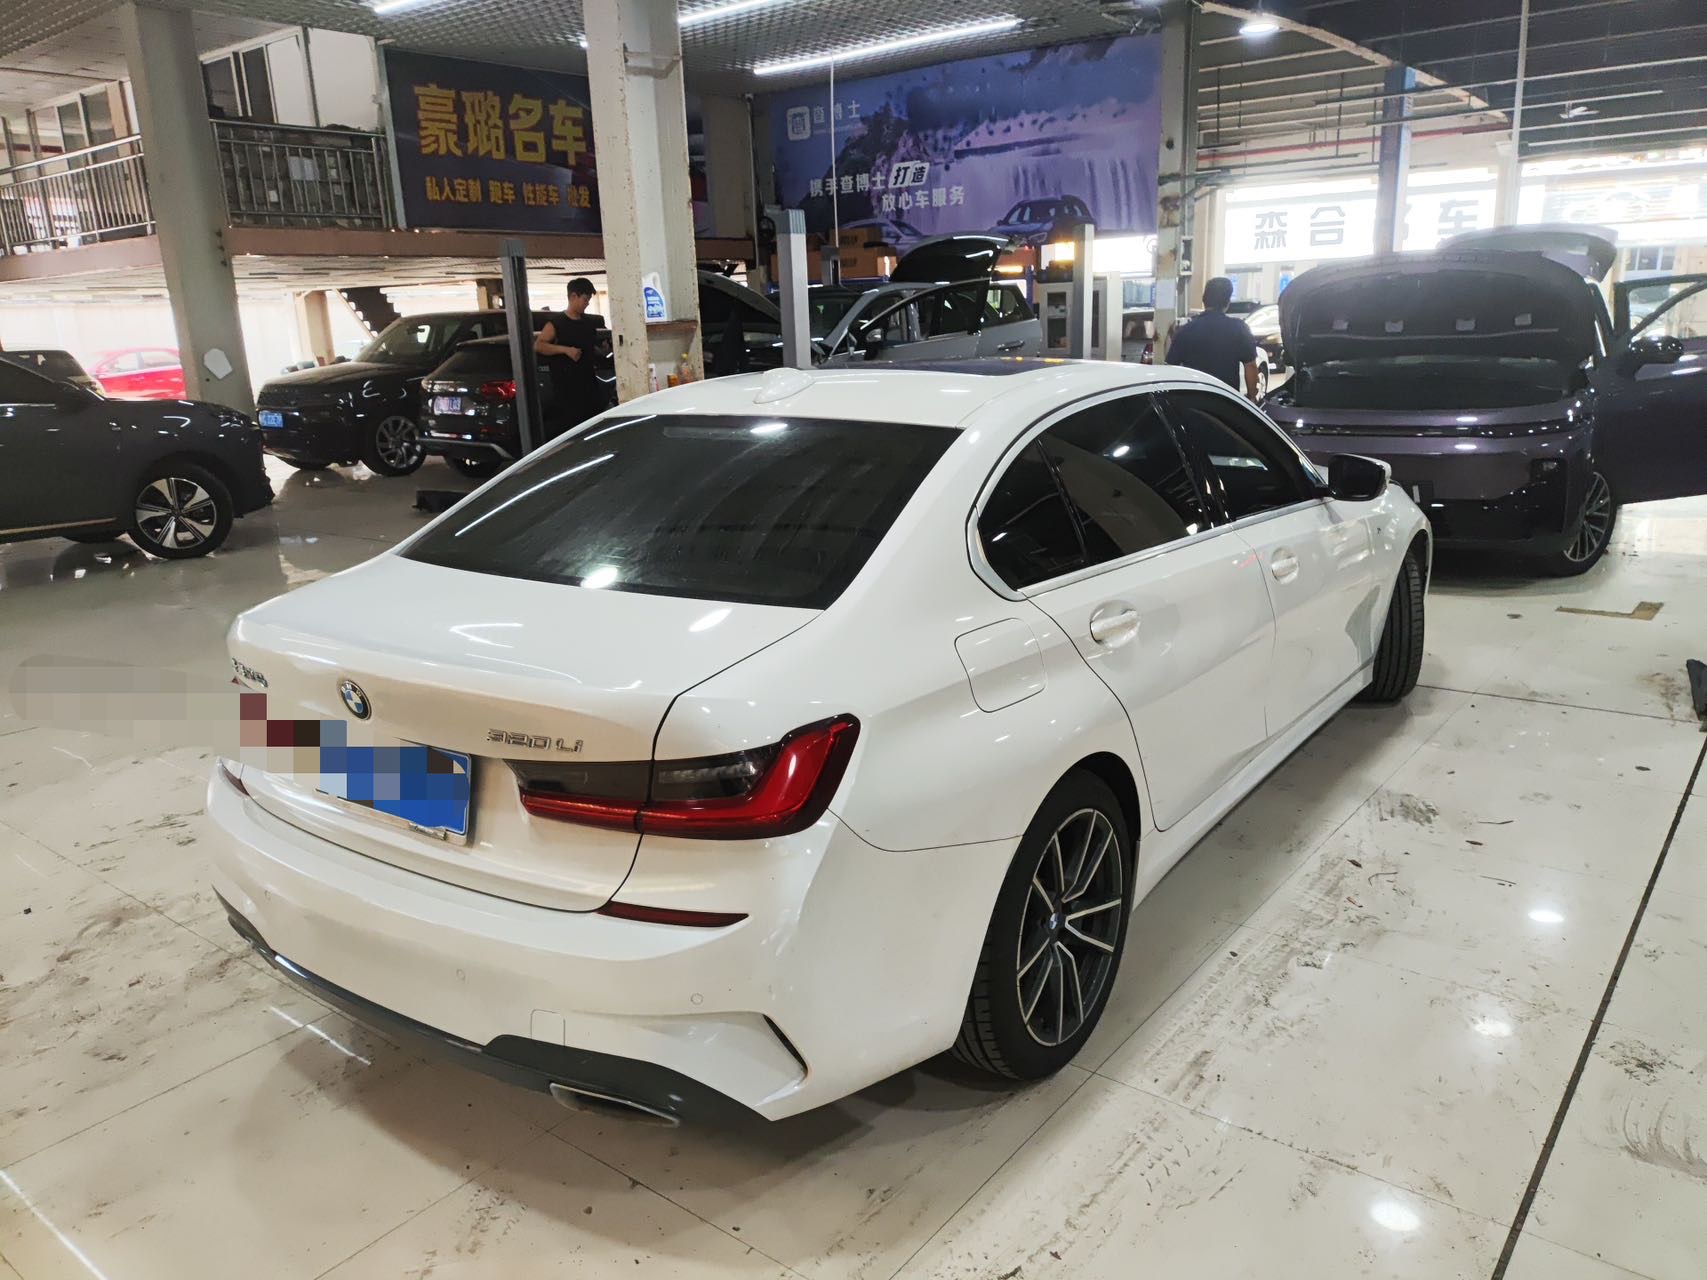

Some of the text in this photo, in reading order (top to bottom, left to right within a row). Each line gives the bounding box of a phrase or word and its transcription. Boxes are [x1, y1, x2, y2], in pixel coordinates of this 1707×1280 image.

[425, 175, 482, 202] 私人定制
[882, 185, 965, 212] 放心车服务
[1254, 199, 1479, 250] 森合车
